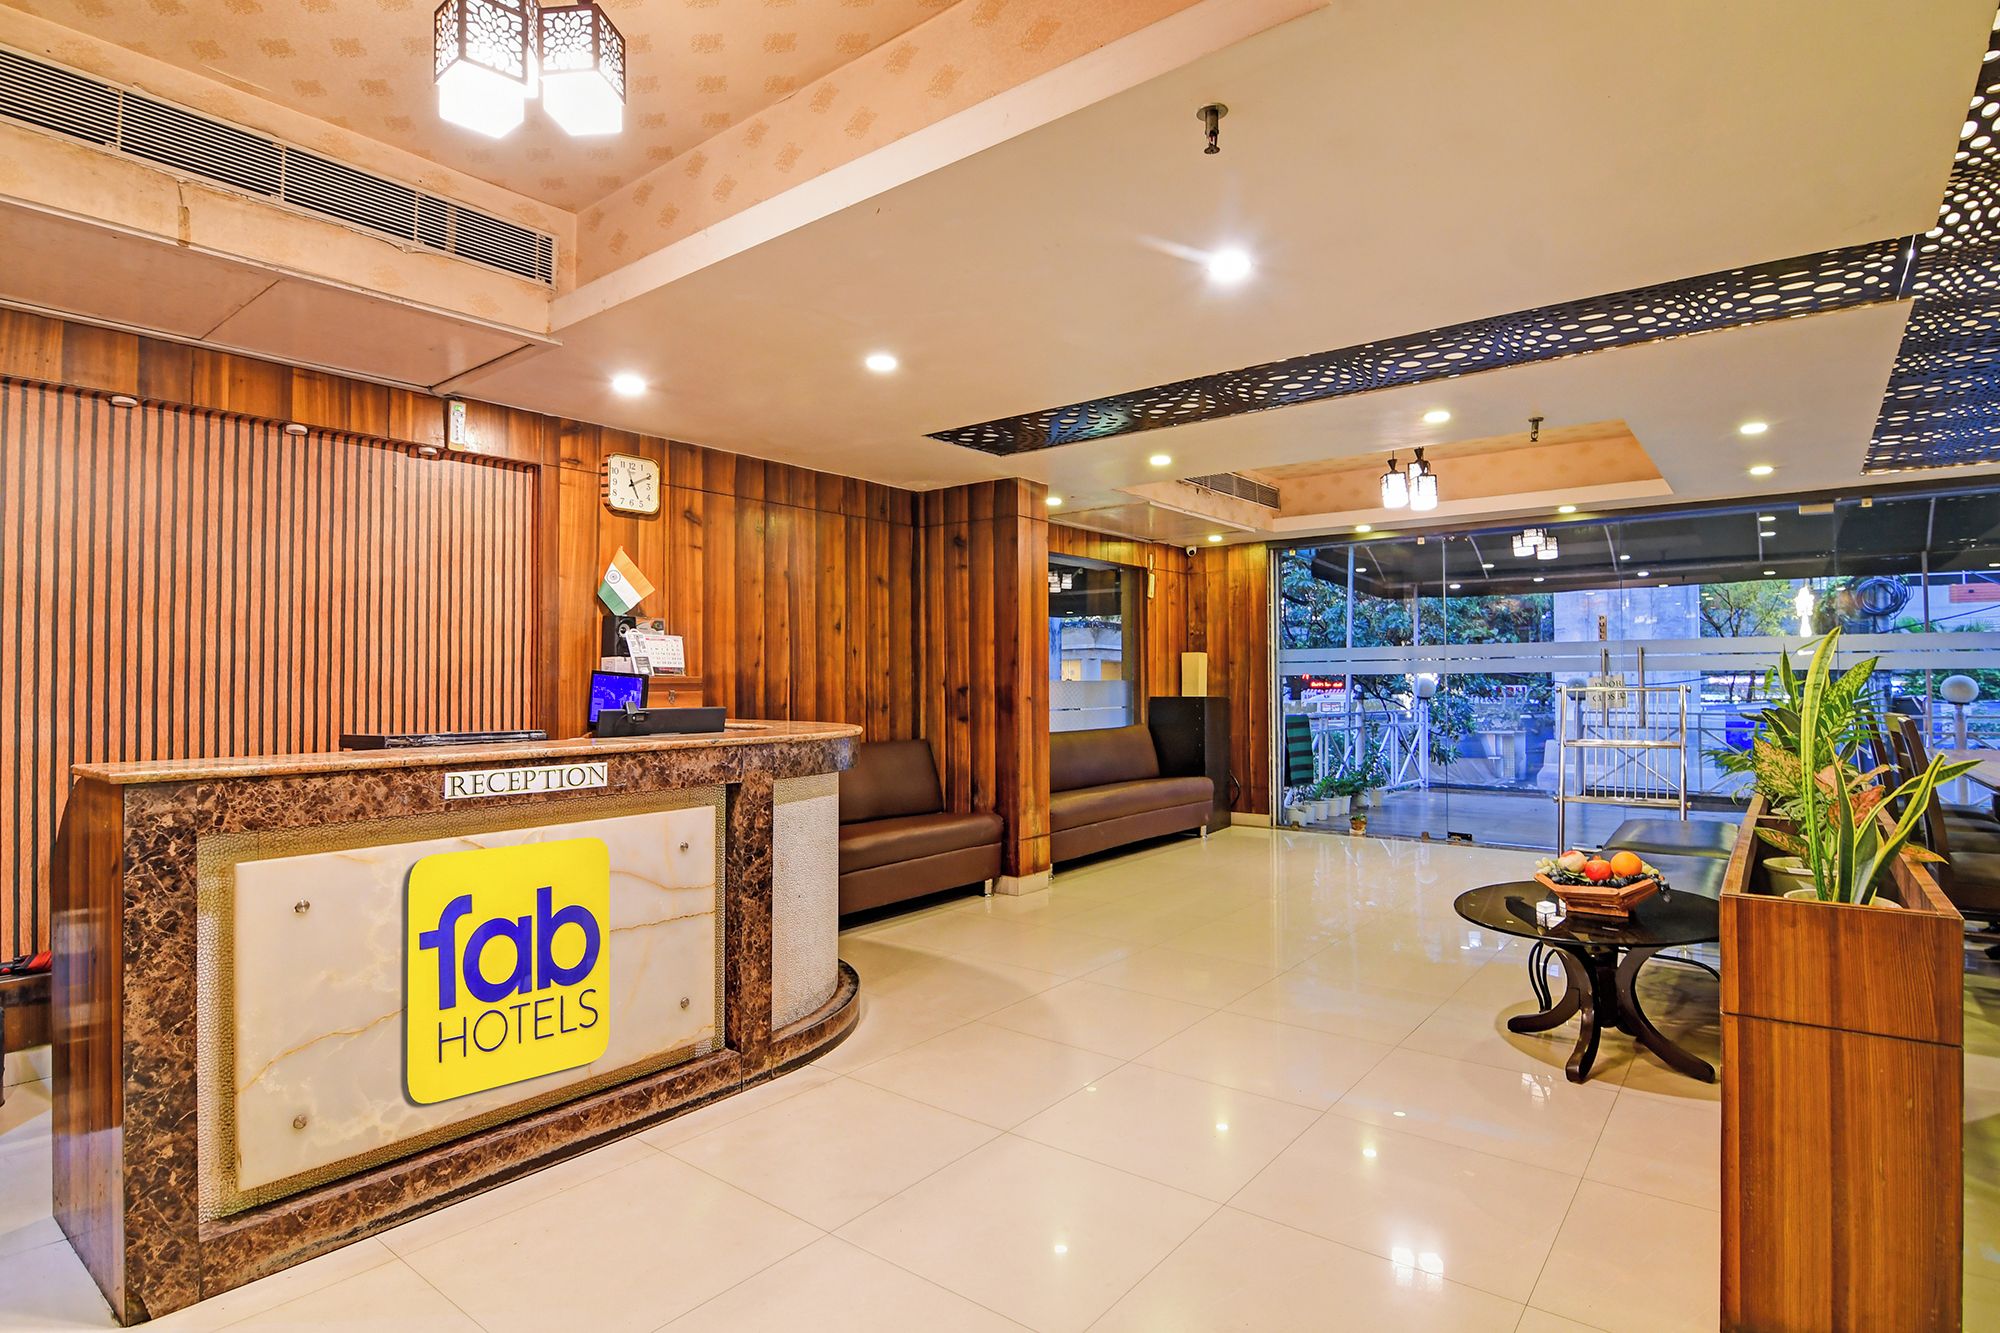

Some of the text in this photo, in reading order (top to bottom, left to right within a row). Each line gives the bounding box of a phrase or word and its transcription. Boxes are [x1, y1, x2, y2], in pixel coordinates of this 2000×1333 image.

[448, 765, 606, 798] RECEPTION
[419, 886, 601, 1011] fab
[438, 988, 599, 1063] HOTELS
